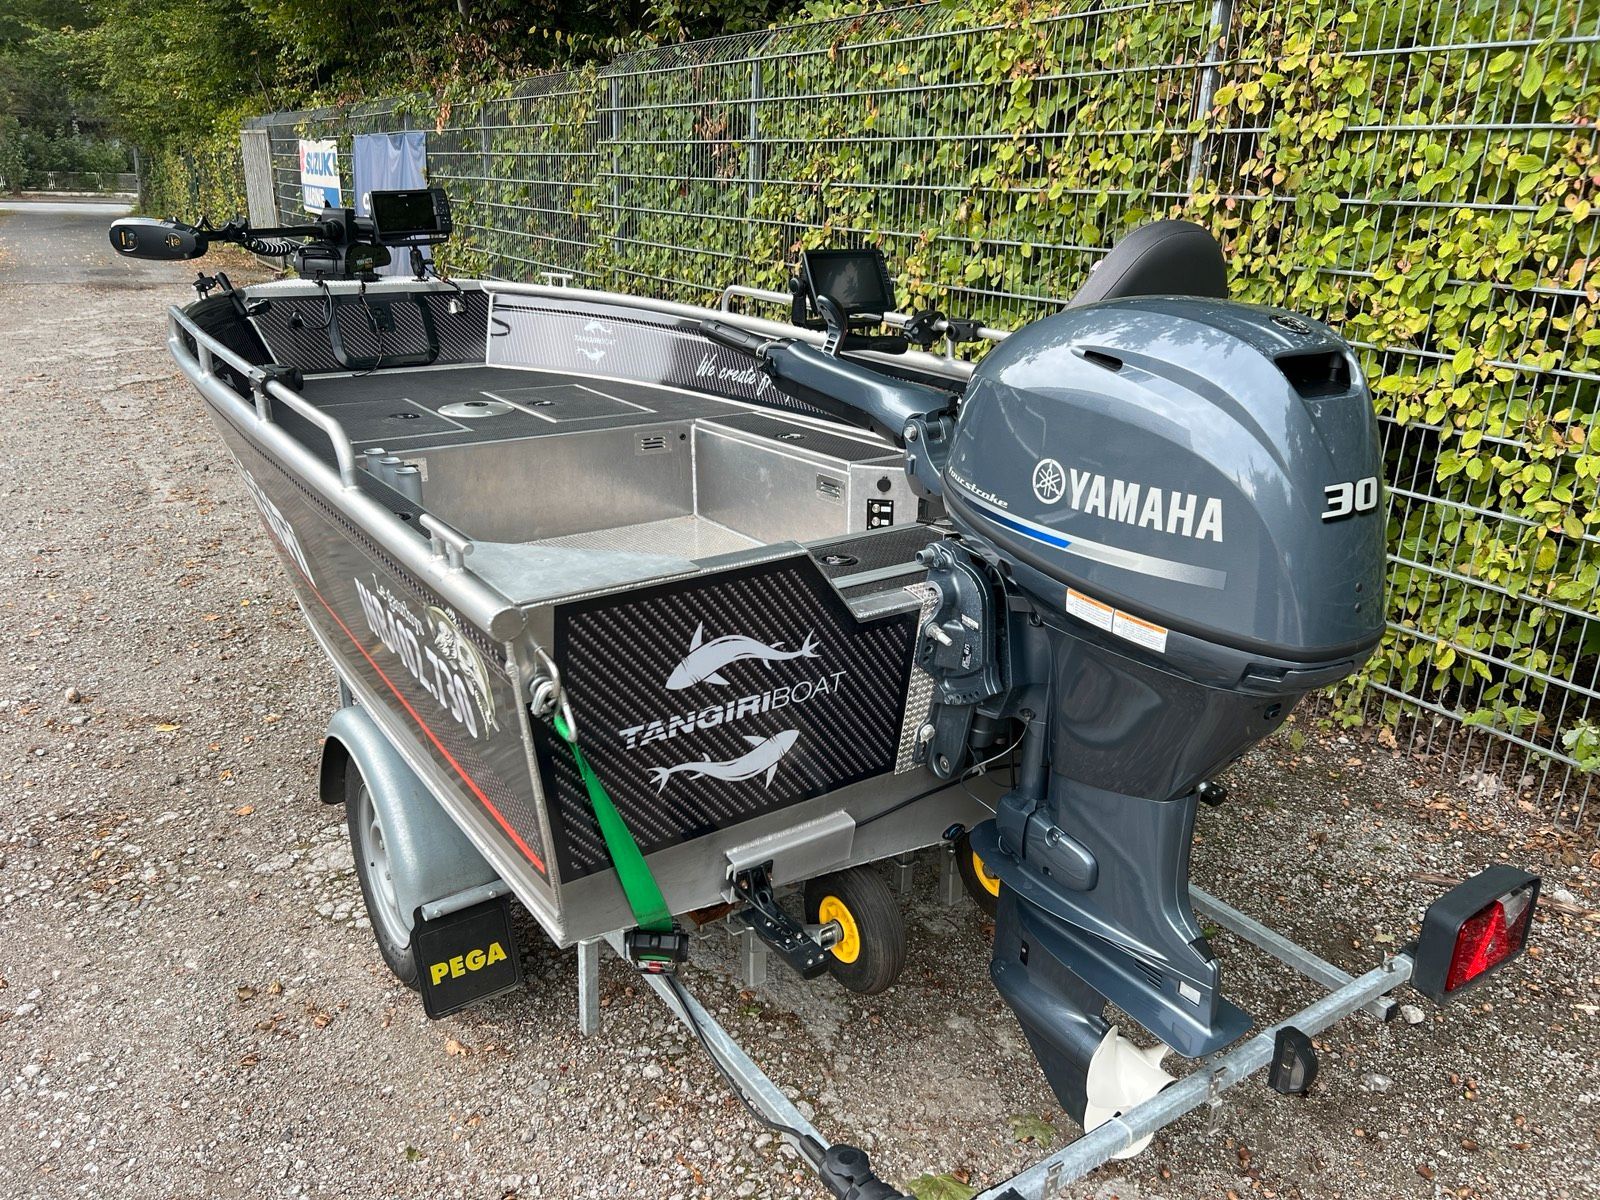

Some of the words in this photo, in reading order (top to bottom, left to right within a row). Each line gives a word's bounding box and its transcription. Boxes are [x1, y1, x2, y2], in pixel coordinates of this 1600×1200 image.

[696, 352, 718, 377] We
[719, 366, 757, 385] create
[1069, 468, 1224, 543] YAMAHA
[1321, 476, 1378, 520] 30
[429, 941, 508, 986] PEGA
